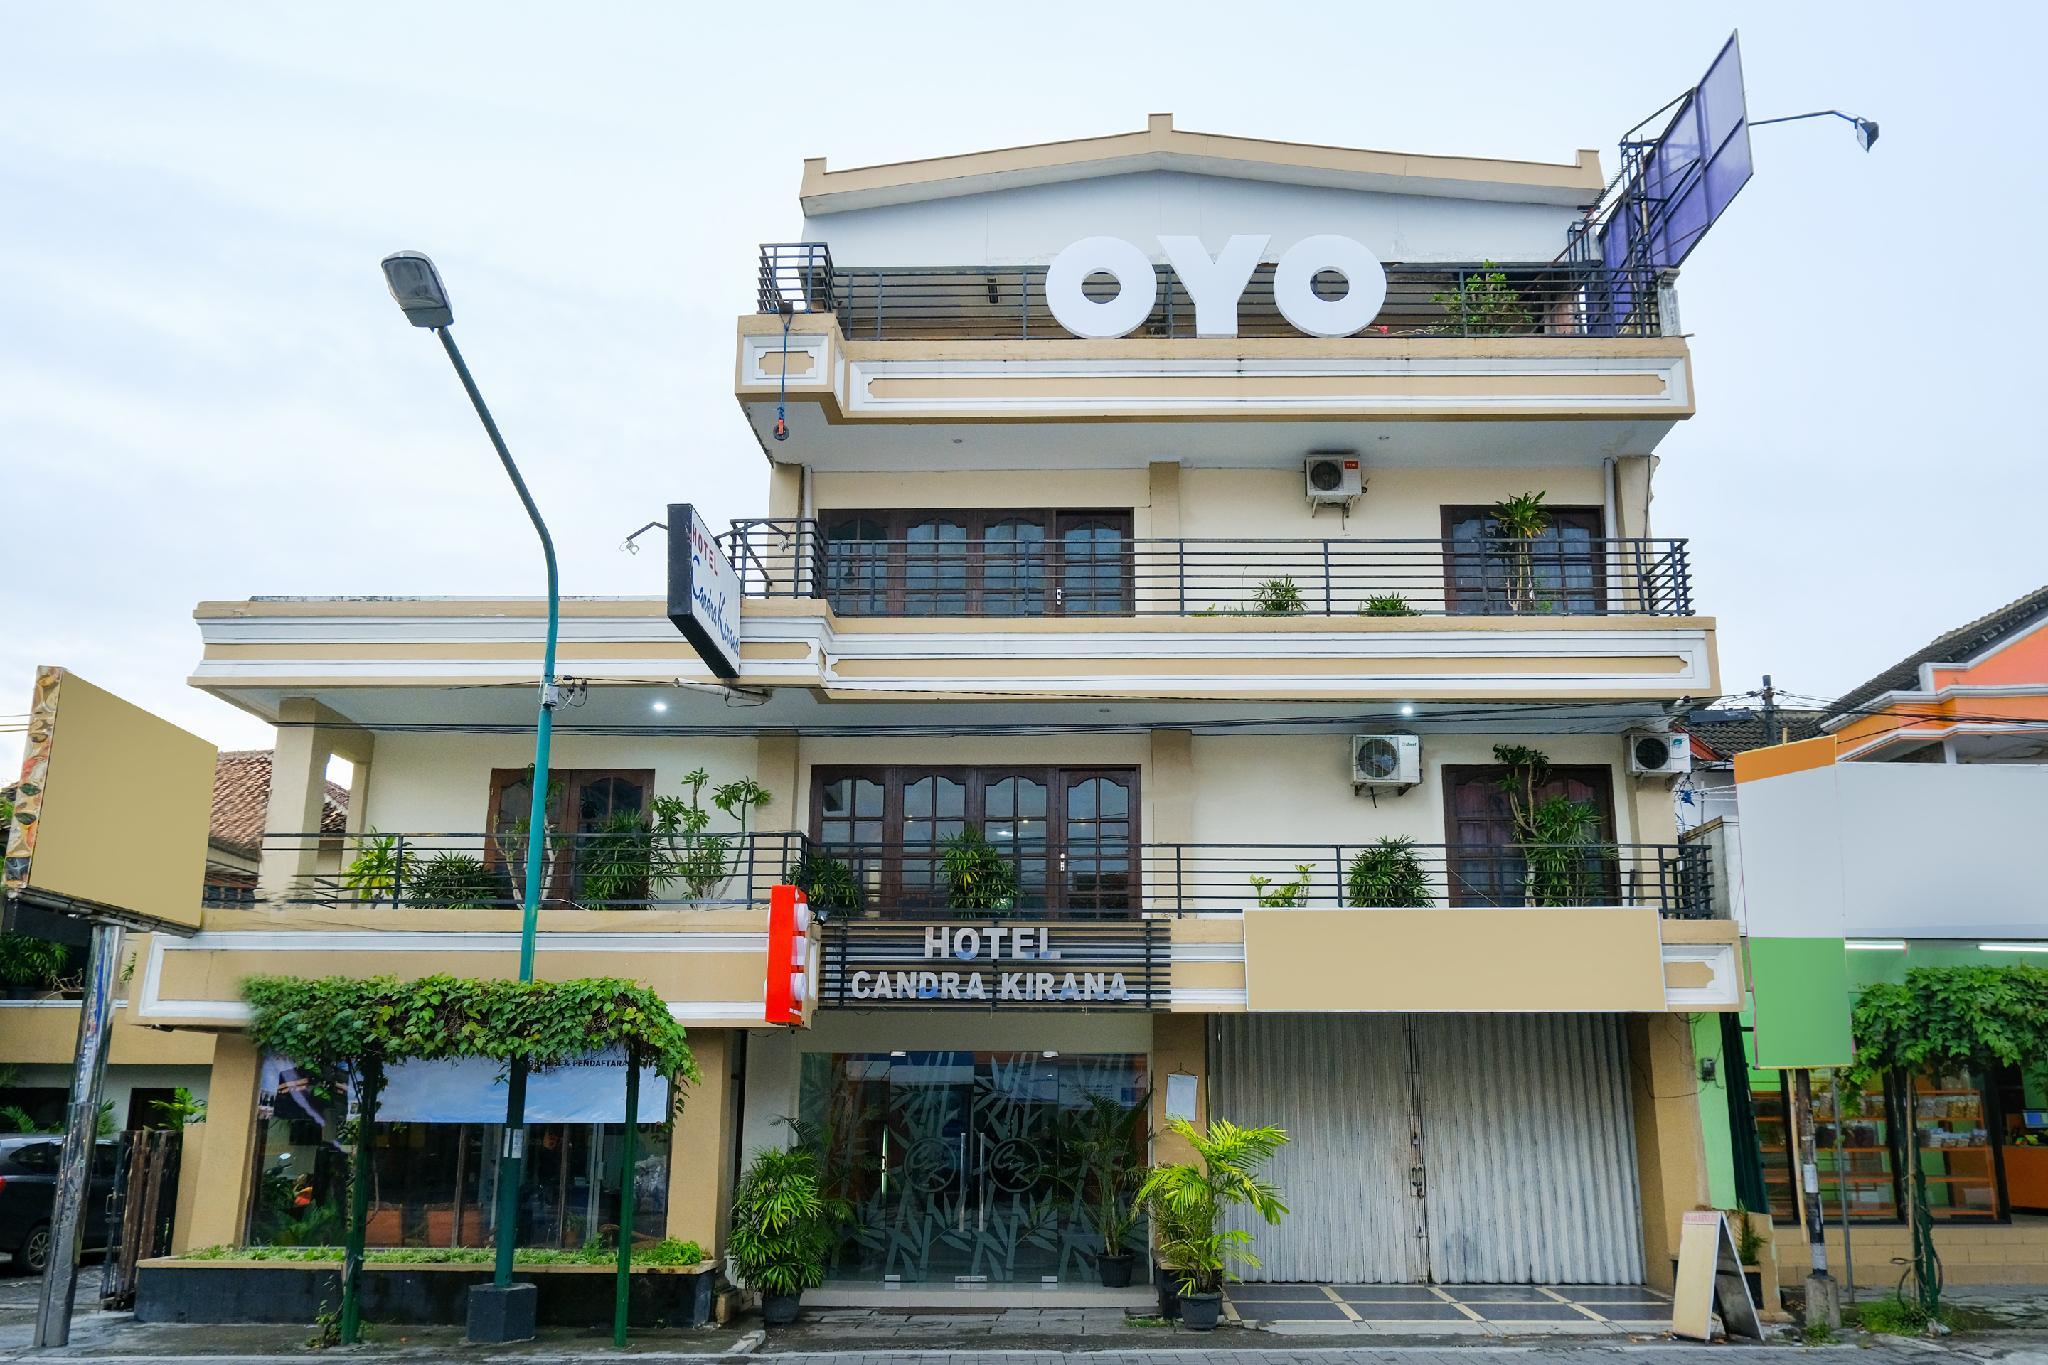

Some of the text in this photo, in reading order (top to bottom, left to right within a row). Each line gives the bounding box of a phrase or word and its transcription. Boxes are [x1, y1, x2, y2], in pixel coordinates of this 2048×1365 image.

[1045, 233, 1388, 339] OYO
[692, 526, 719, 576] HOTEL
[924, 927, 1062, 961] HOTEL
[851, 971, 1131, 1001] CANDRA KIRANA
[572, 1058, 629, 1067] PENDAFTARA
